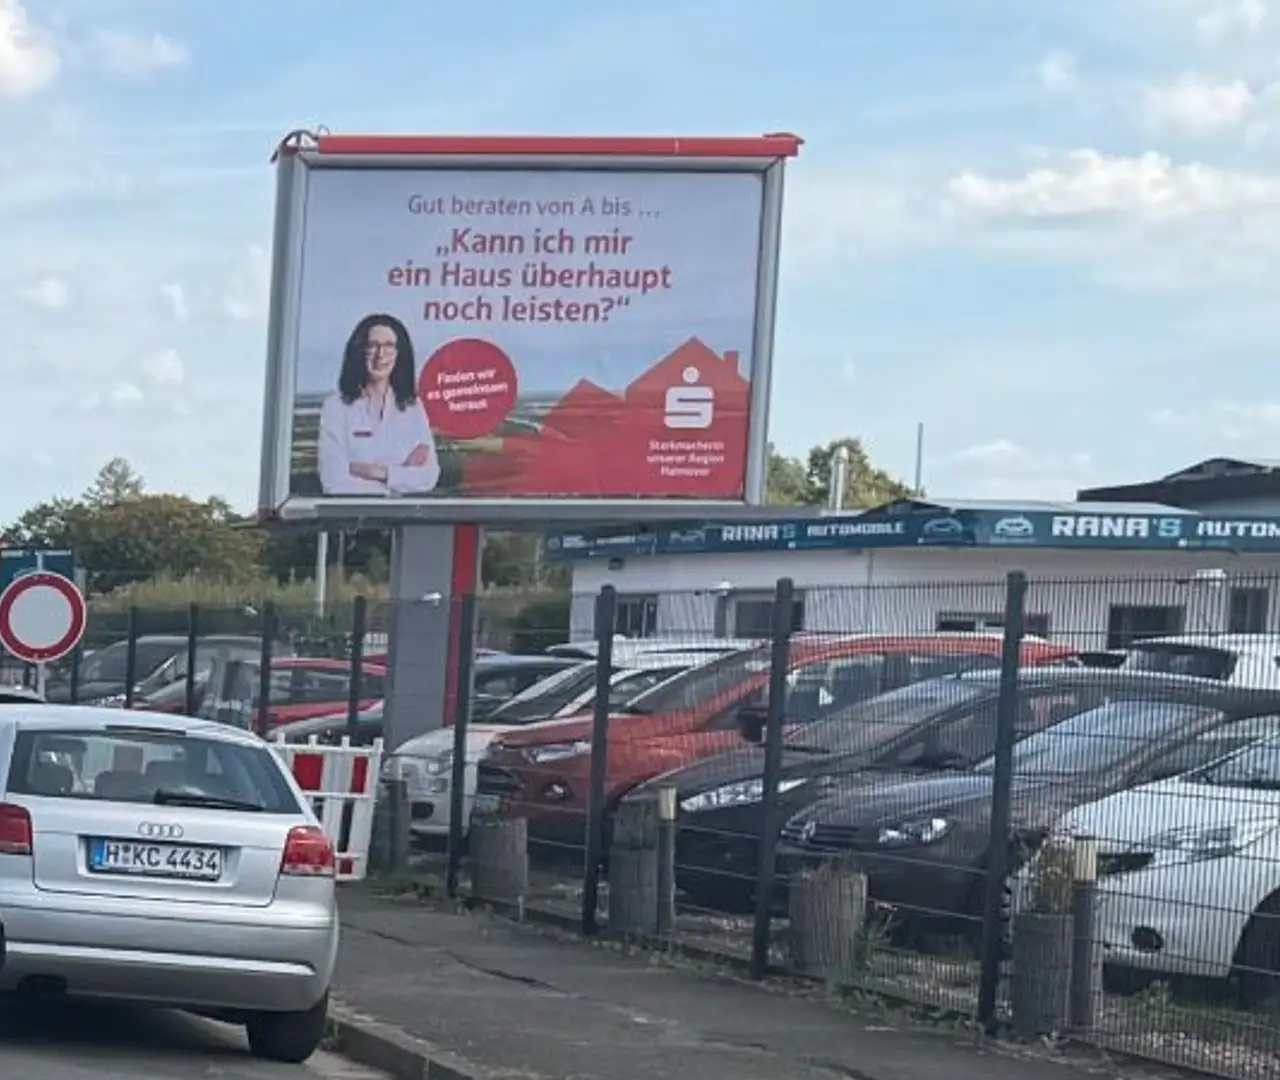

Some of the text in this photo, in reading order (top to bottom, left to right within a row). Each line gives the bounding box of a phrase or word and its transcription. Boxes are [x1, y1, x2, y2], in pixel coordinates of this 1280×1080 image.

[408, 194, 443, 216] Gut
[451, 196, 531, 216] beraten
[536, 199, 574, 216] von
[580, 197, 595, 215] A
[601, 197, 632, 217] bis
[535, 228, 575, 254] ich
[584, 229, 633, 255] mir
[388, 260, 672, 295] ein Haus überhaupt
[423, 296, 492, 321] noch
[1051, 516, 1183, 537] RANA'S
[133, 847, 160, 867] KC
[166, 850, 218, 871] 4434
